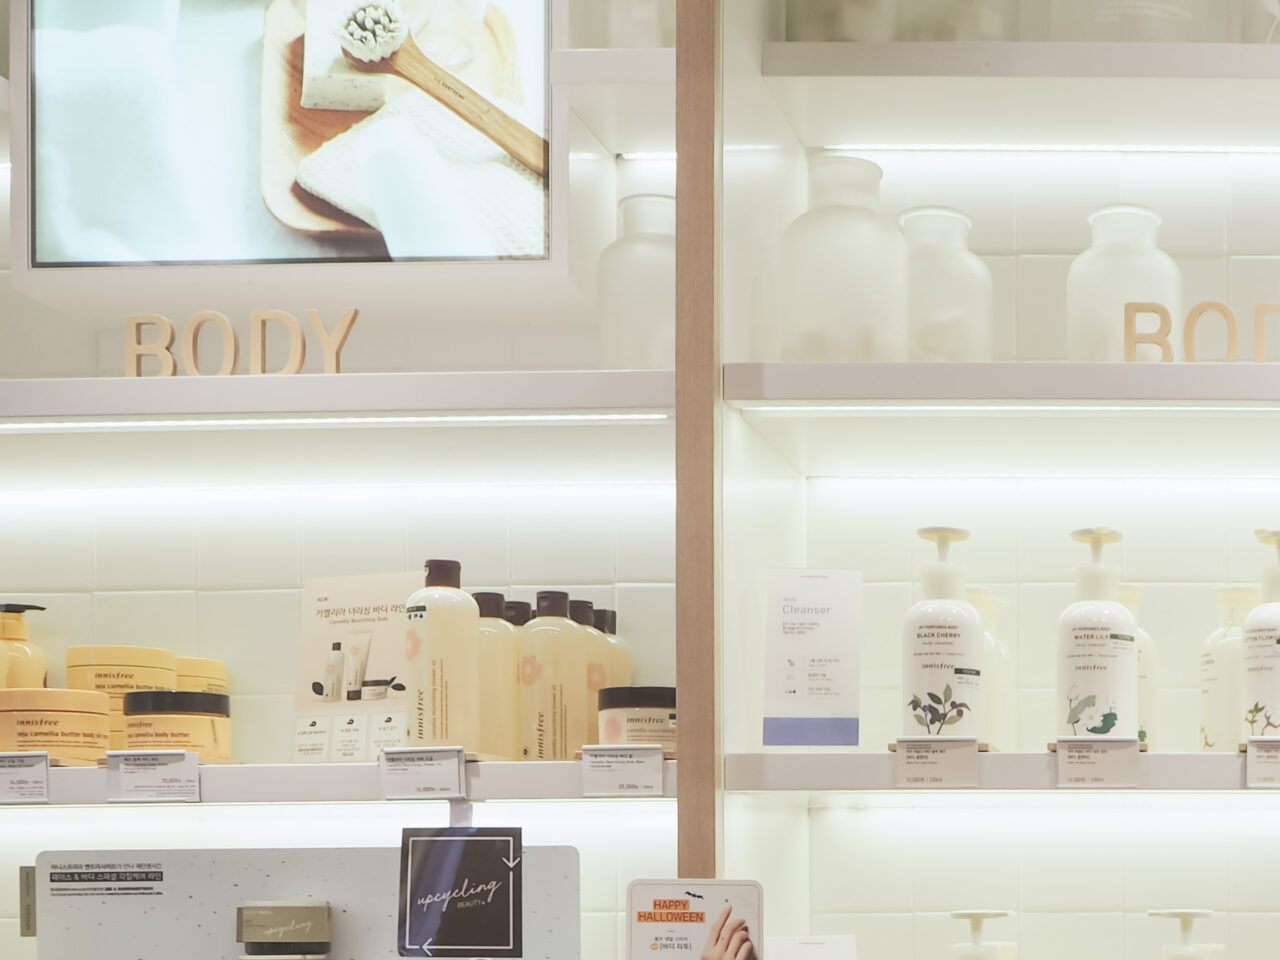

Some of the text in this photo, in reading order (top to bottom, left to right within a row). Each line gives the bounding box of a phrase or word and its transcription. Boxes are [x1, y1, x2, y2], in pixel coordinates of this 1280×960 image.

[125, 308, 360, 378] BODY
[373, 604, 389, 614] 바디
[782, 604, 831, 615] Cleanser
[95, 672, 135, 680] innisfree
[416, 688, 425, 740] innisfree
[17, 719, 59, 727] innisfree
[626, 716, 665, 724] innisfree
[536, 711, 546, 759] innisfree
[417, 878, 503, 913] upcycling
[654, 901, 688, 910] HAPPY
[638, 912, 704, 922] HALLOWEEN
